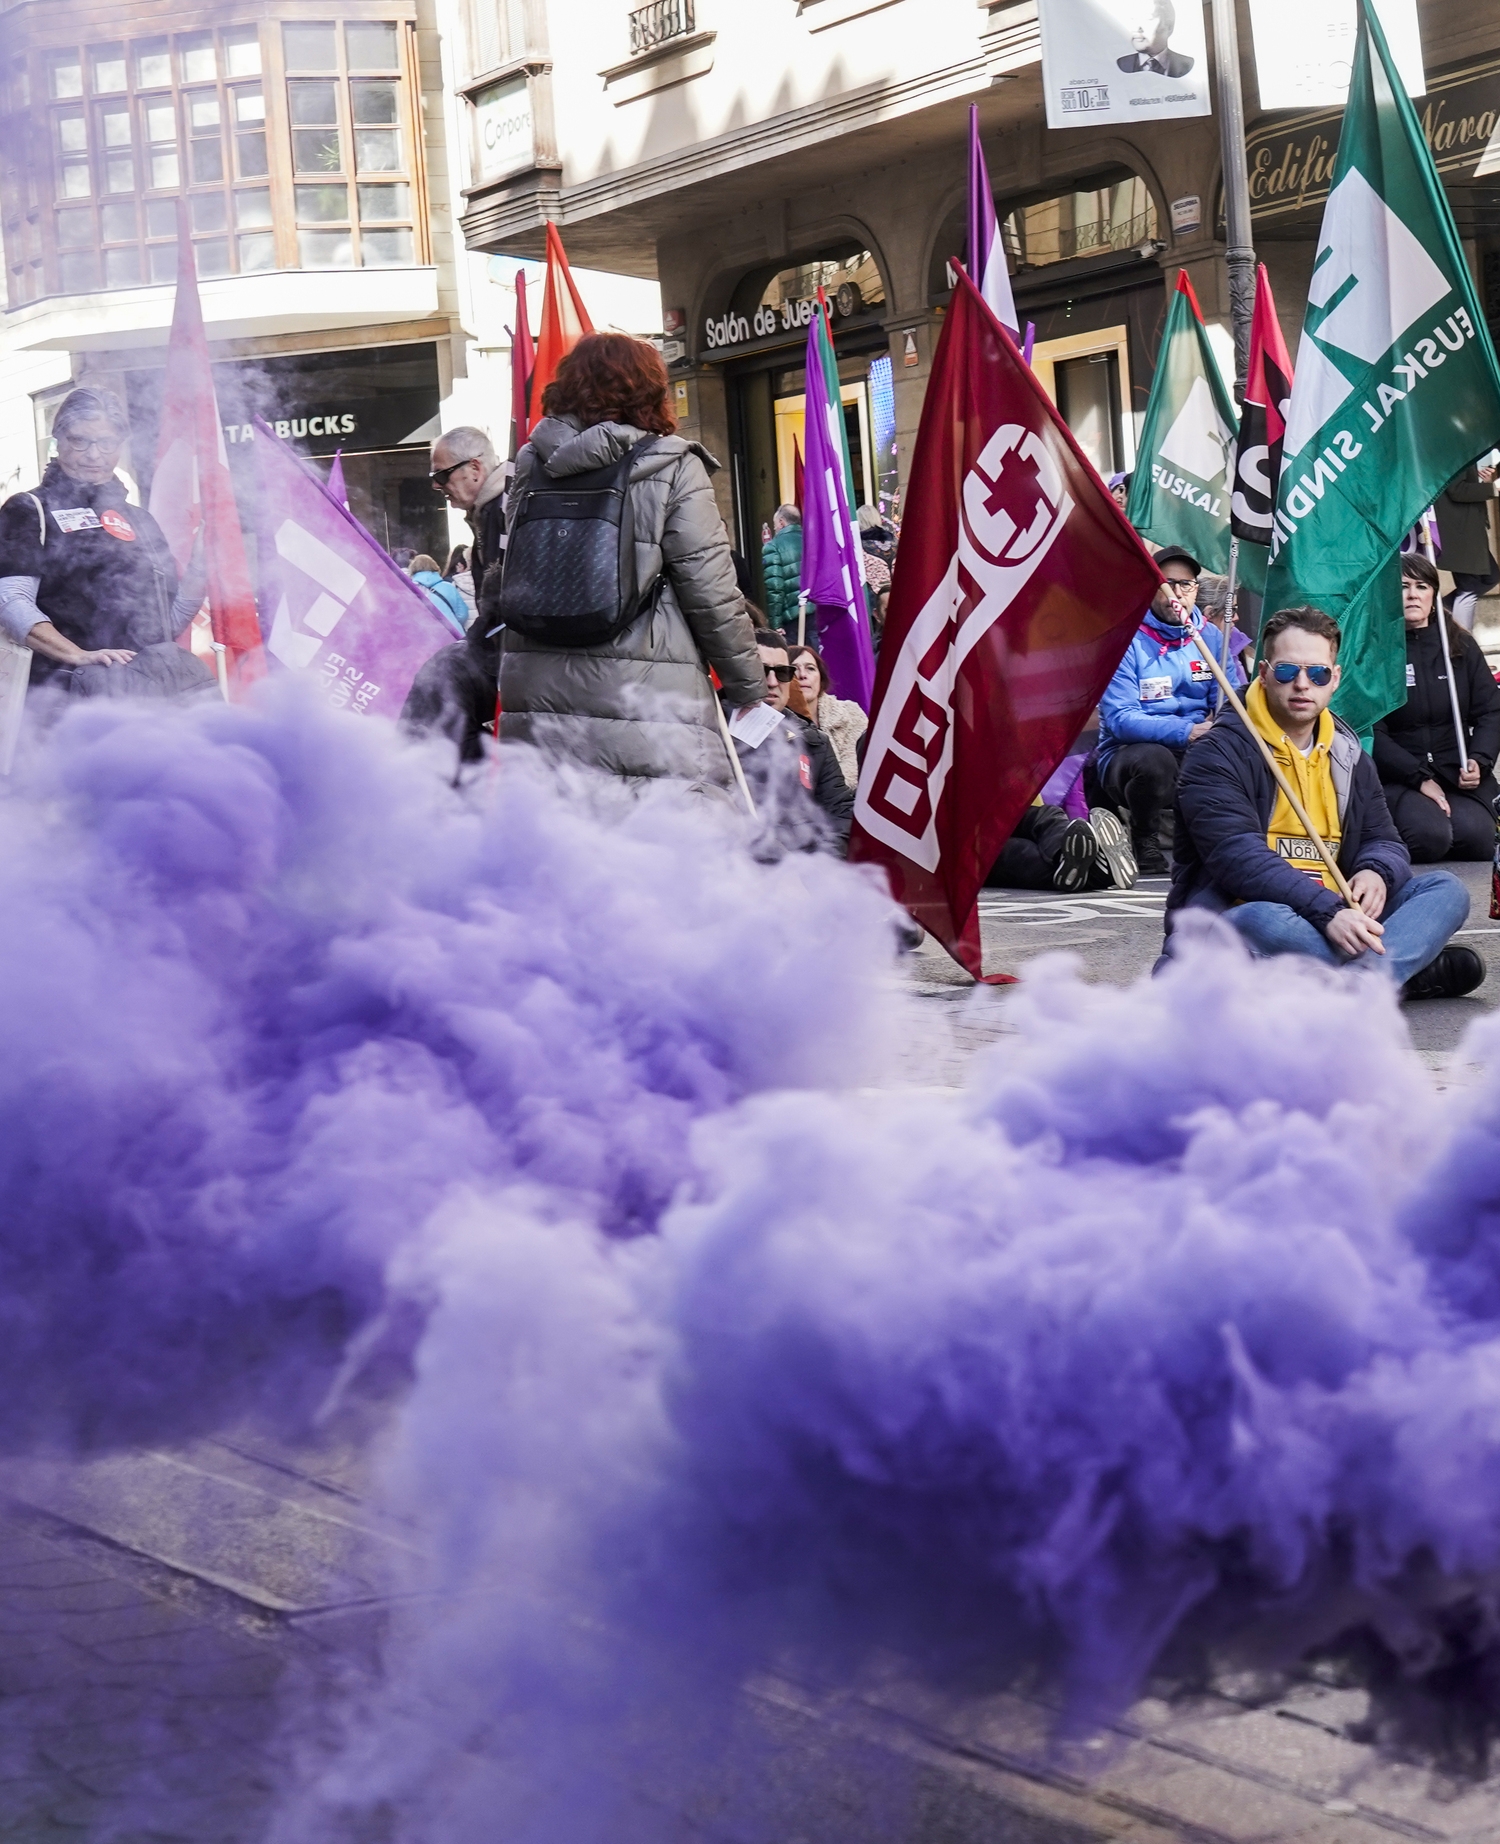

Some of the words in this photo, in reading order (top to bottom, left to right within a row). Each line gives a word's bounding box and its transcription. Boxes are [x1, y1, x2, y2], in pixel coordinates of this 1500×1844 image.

[705, 311, 750, 348] Salón
[753, 304, 776, 337] de
[222, 413, 356, 444] TABUCKS
[1151, 463, 1222, 517] EUSKAL
